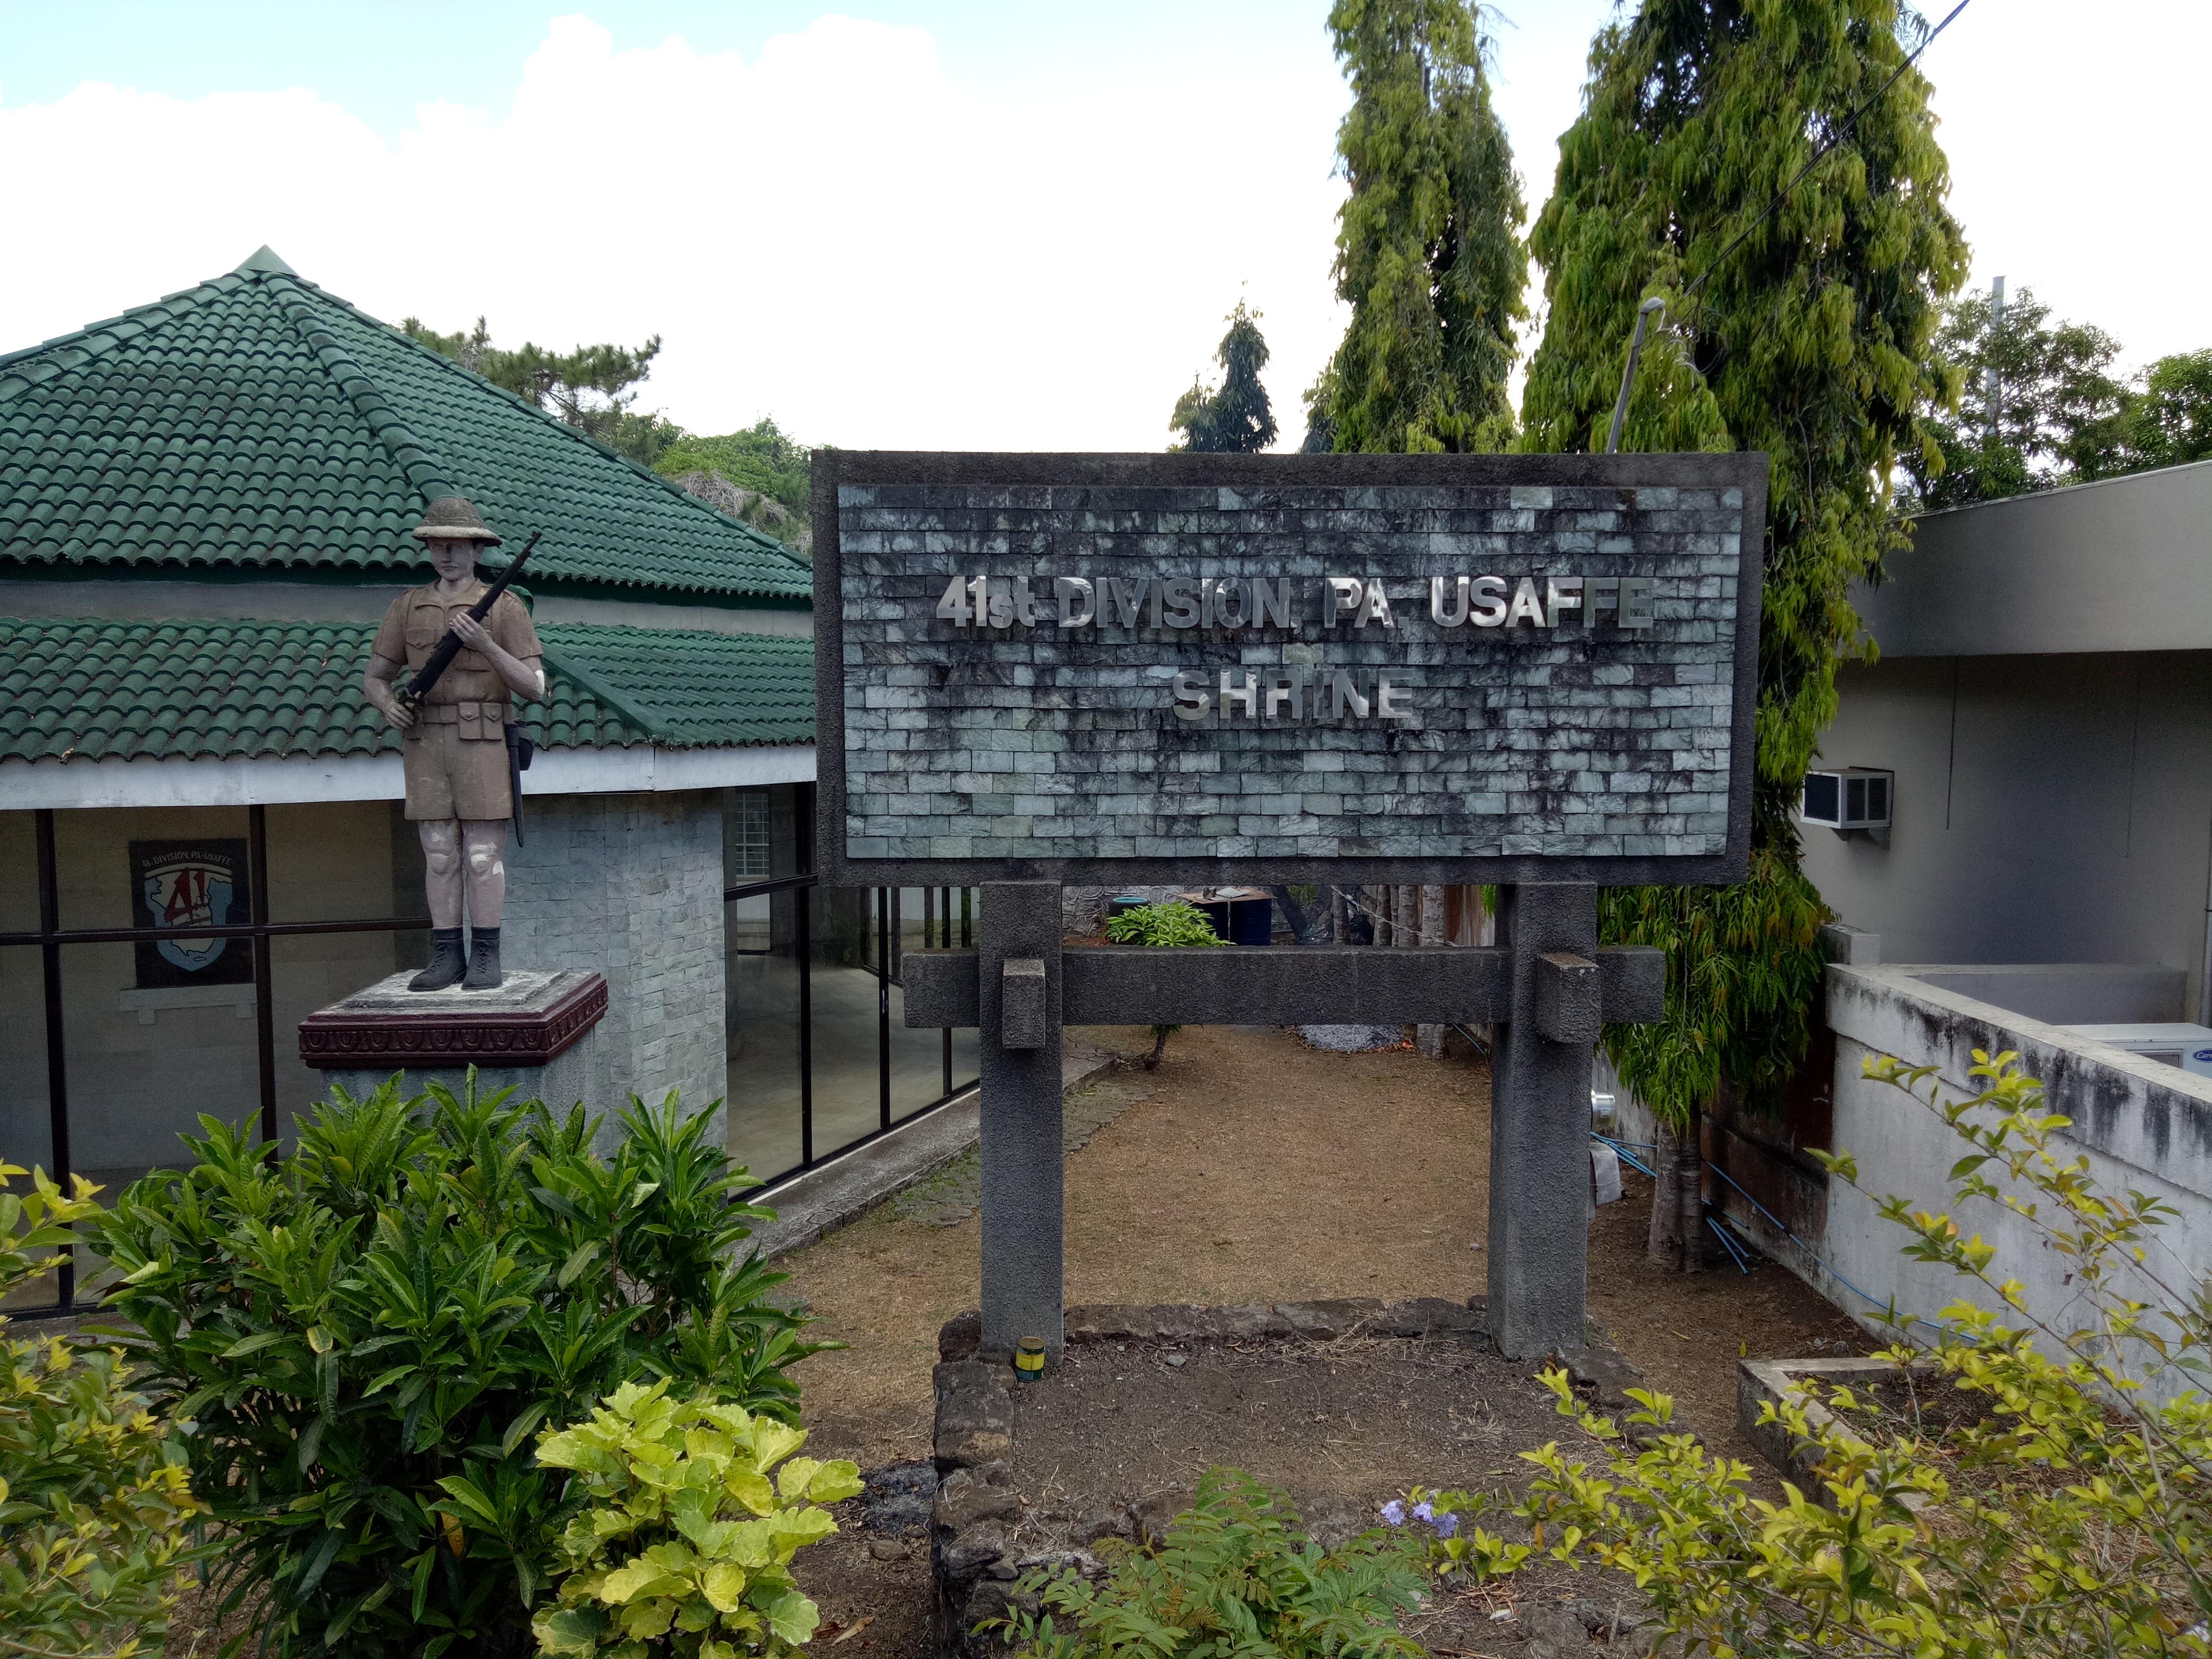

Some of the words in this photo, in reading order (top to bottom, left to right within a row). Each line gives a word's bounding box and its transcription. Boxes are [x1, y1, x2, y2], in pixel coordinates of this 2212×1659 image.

[936, 575, 1035, 629] 41st
[1058, 576, 1301, 634] DIVISION,
[1324, 577, 1410, 636] PA,
[1431, 576, 1654, 629] USAFFE
[1172, 668, 1413, 720] SHRINE
